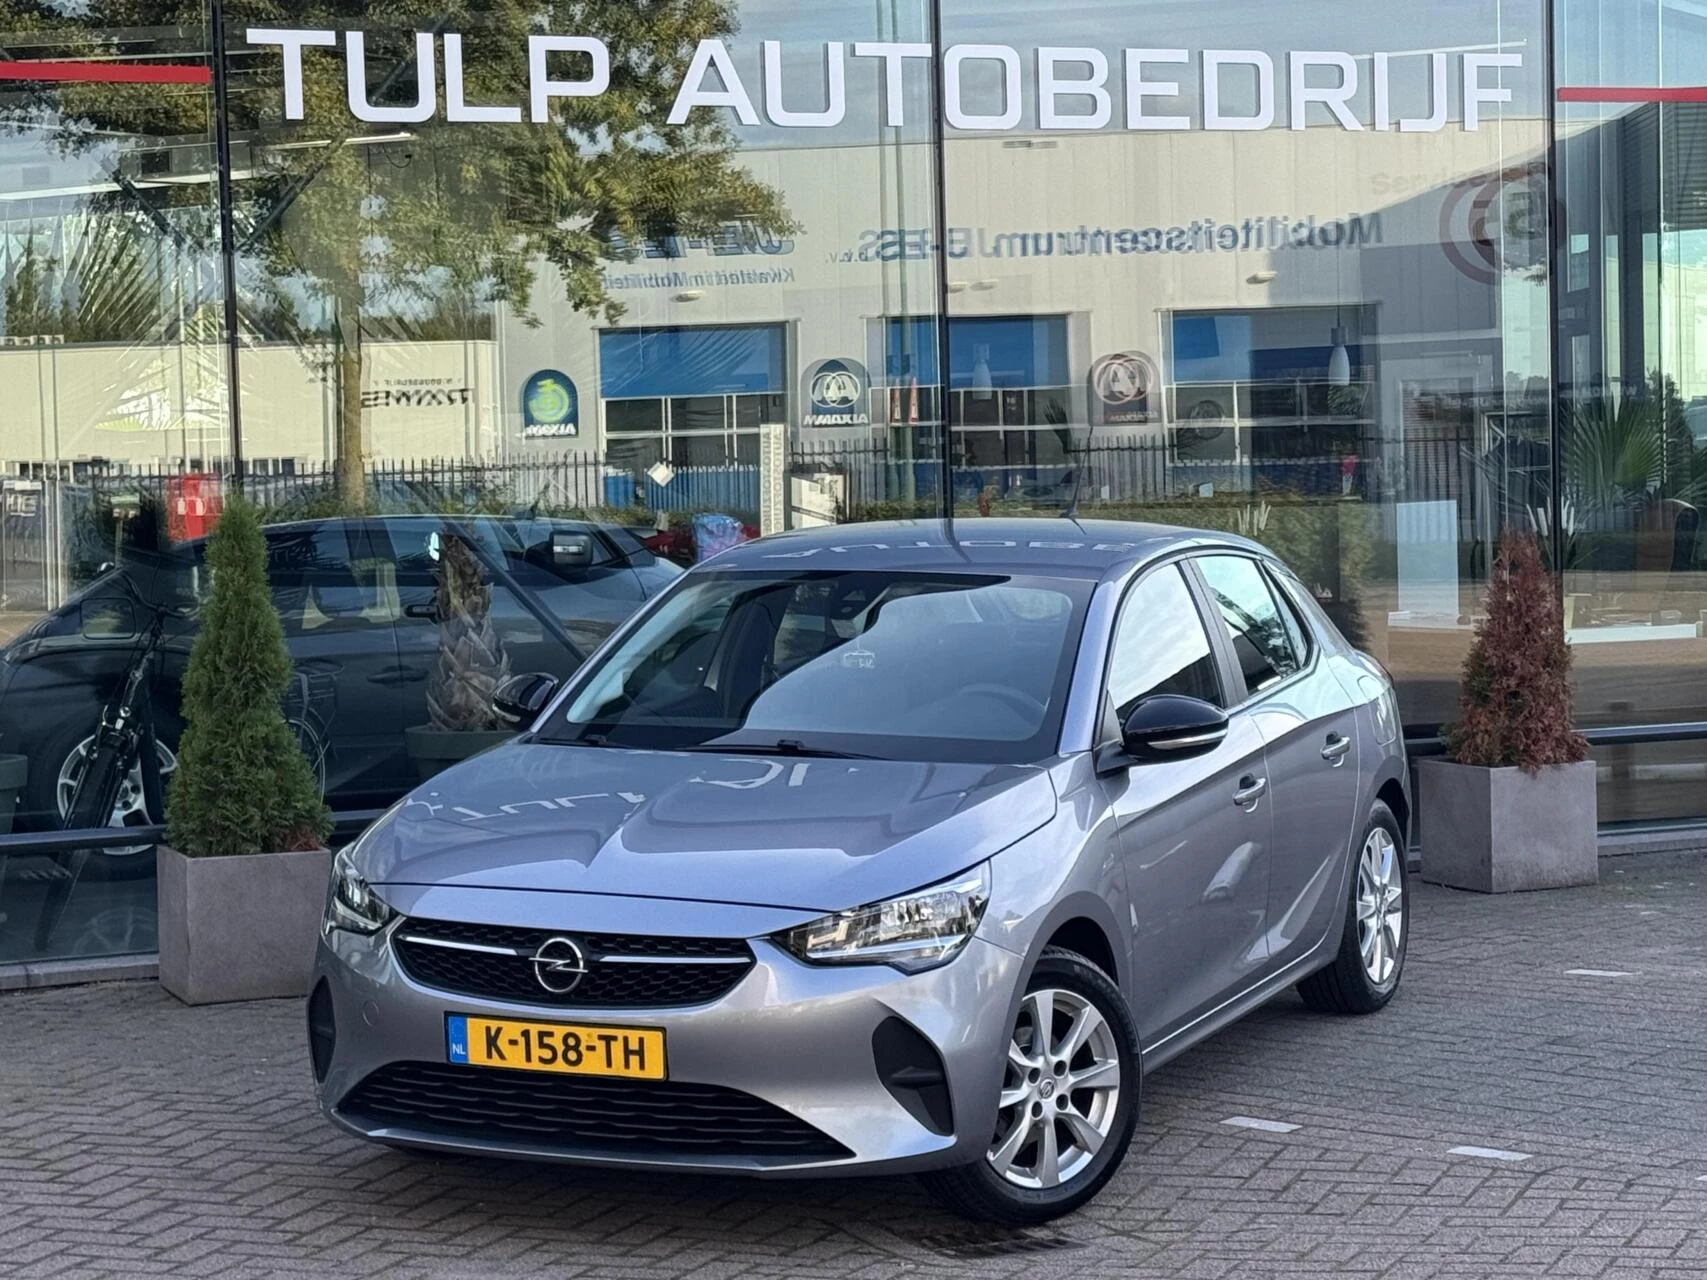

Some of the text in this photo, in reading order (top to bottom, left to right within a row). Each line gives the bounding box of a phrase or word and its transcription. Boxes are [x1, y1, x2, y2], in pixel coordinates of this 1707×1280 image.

[246, 28, 1523, 133] TULP AUTOBEDRIJF
[452, 1026, 645, 1070] NL K-158-TH
